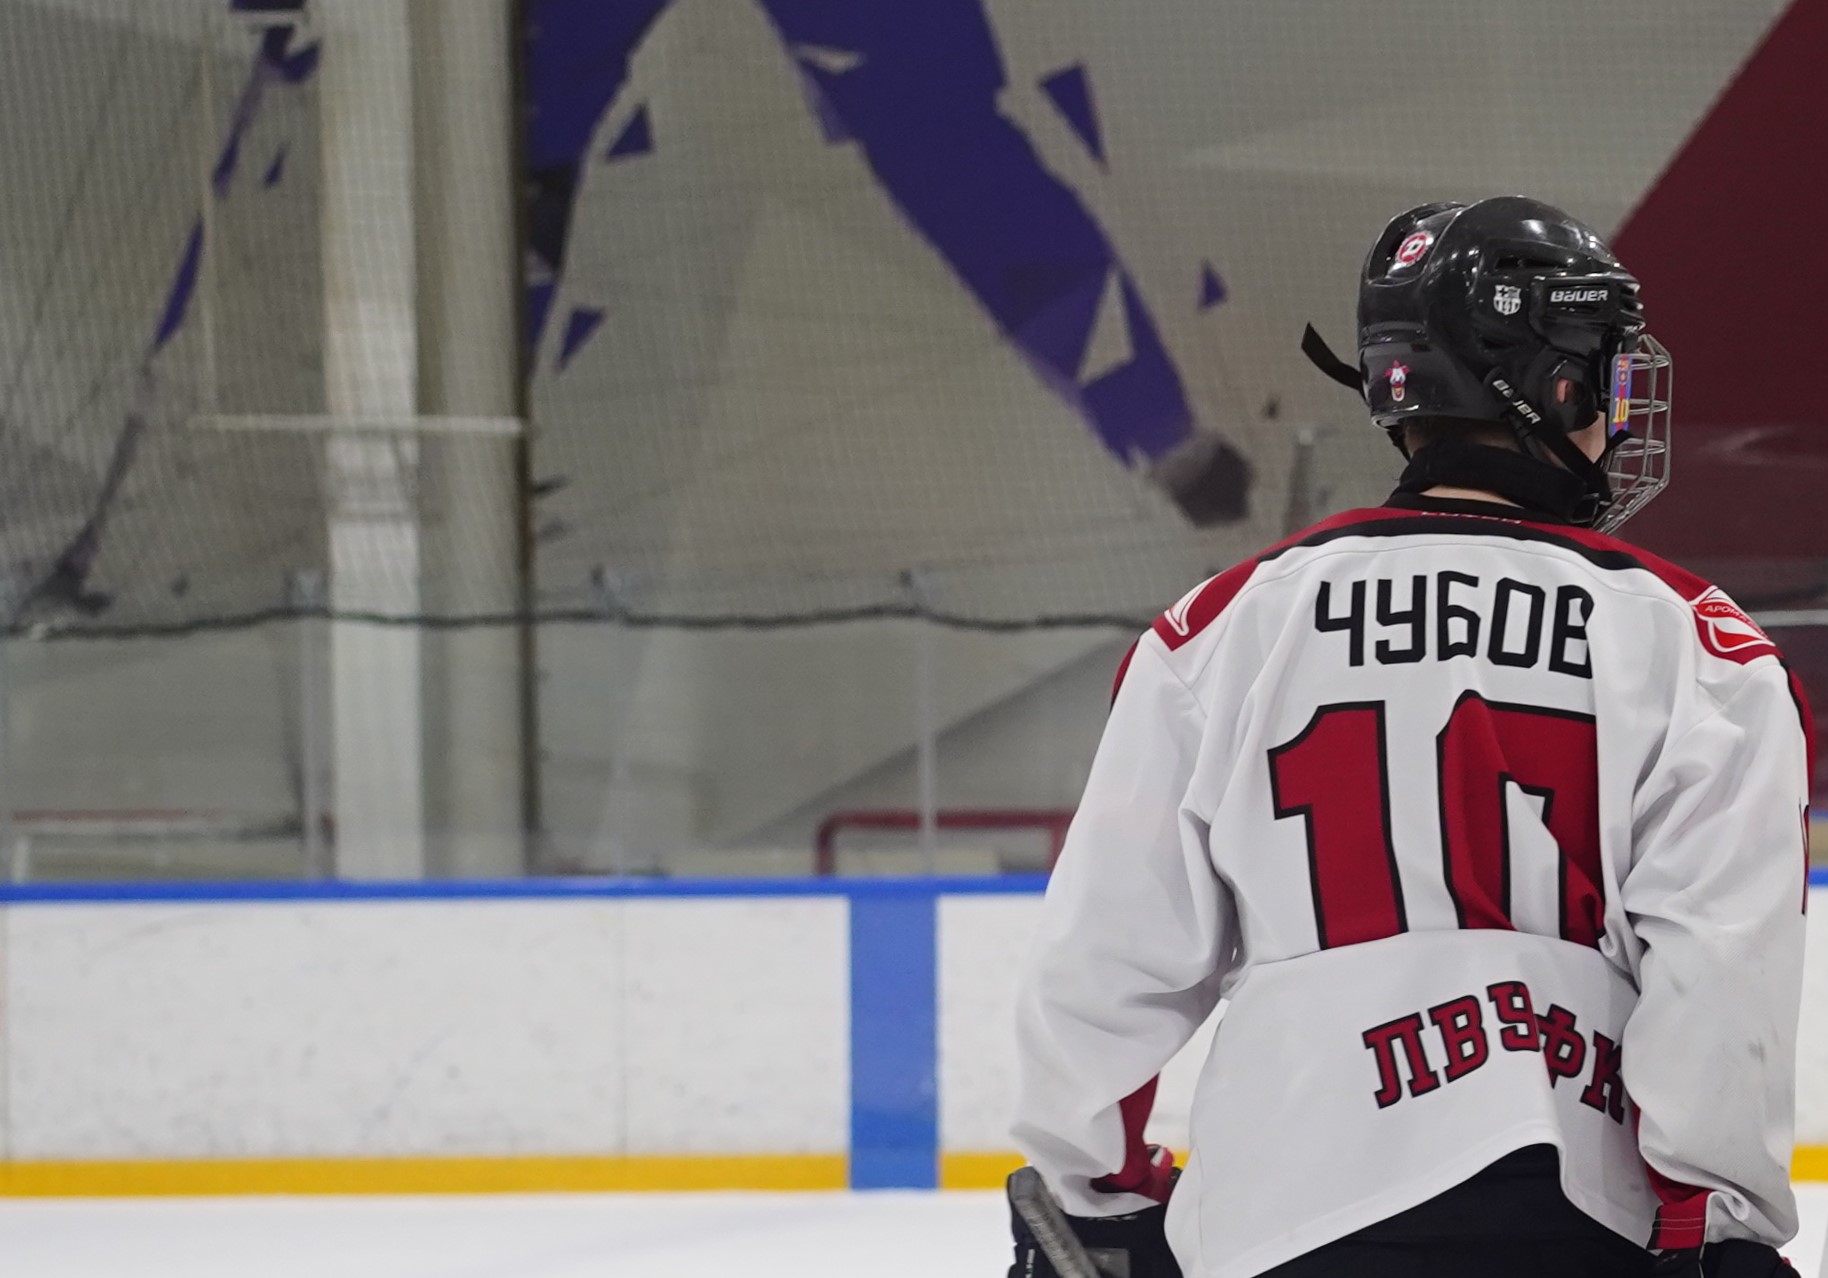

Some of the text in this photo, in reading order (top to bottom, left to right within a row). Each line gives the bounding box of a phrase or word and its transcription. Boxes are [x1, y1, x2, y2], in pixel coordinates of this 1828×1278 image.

[1550, 289, 1609, 304] BAUER
[1314, 570, 1597, 679] ЧУБОВ
[1266, 688, 1607, 952] 10
